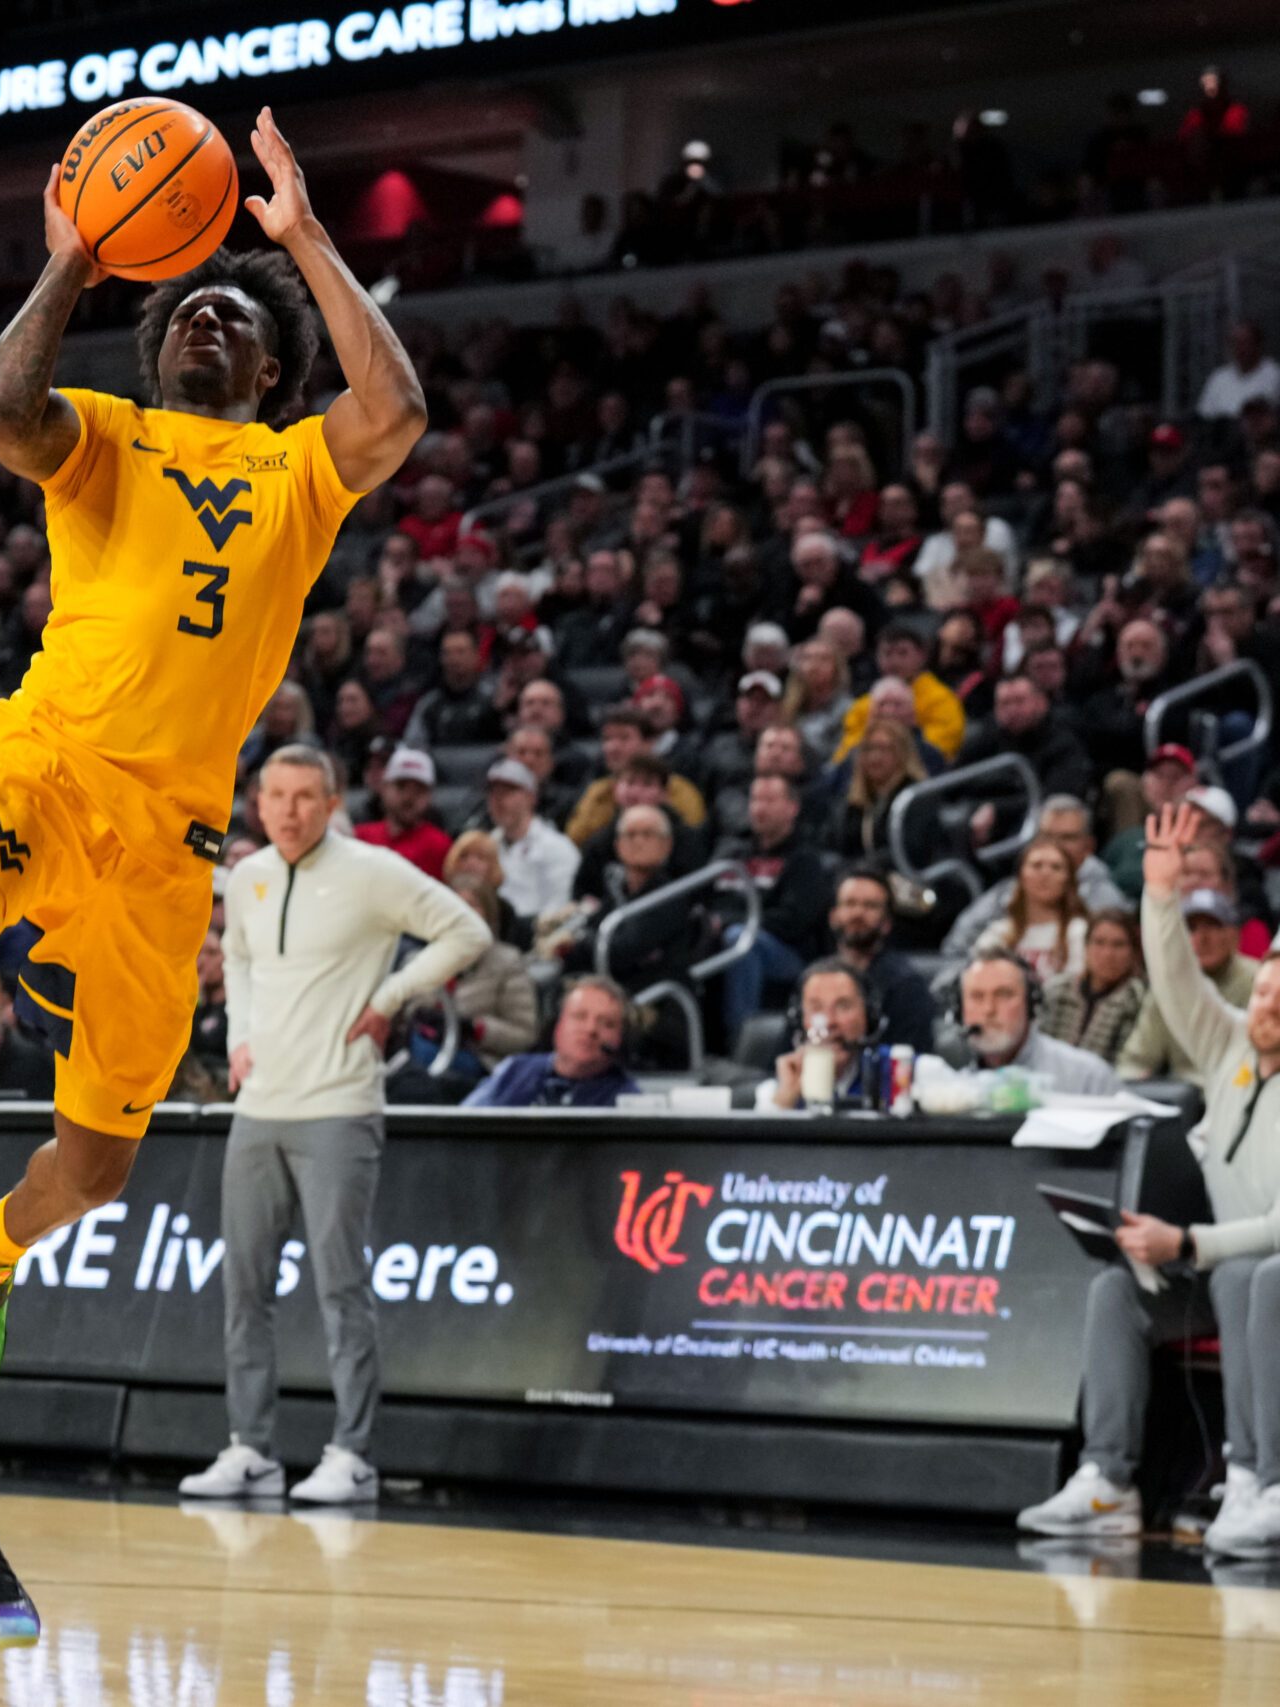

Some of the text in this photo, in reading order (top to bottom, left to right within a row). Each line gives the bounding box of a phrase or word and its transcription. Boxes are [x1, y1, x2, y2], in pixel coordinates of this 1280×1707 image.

[69, 48, 137, 101] OF
[140, 19, 331, 91] CANCER
[334, 0, 465, 62] CARE
[111, 129, 166, 192] EVO
[177, 559, 229, 639] 3
[721, 1172, 888, 1210] University of
[135, 1203, 306, 1297] livs
[364, 1242, 514, 1305] ere.
[706, 1208, 1016, 1270] CINCINNATI
[697, 1267, 849, 1310] CANCER
